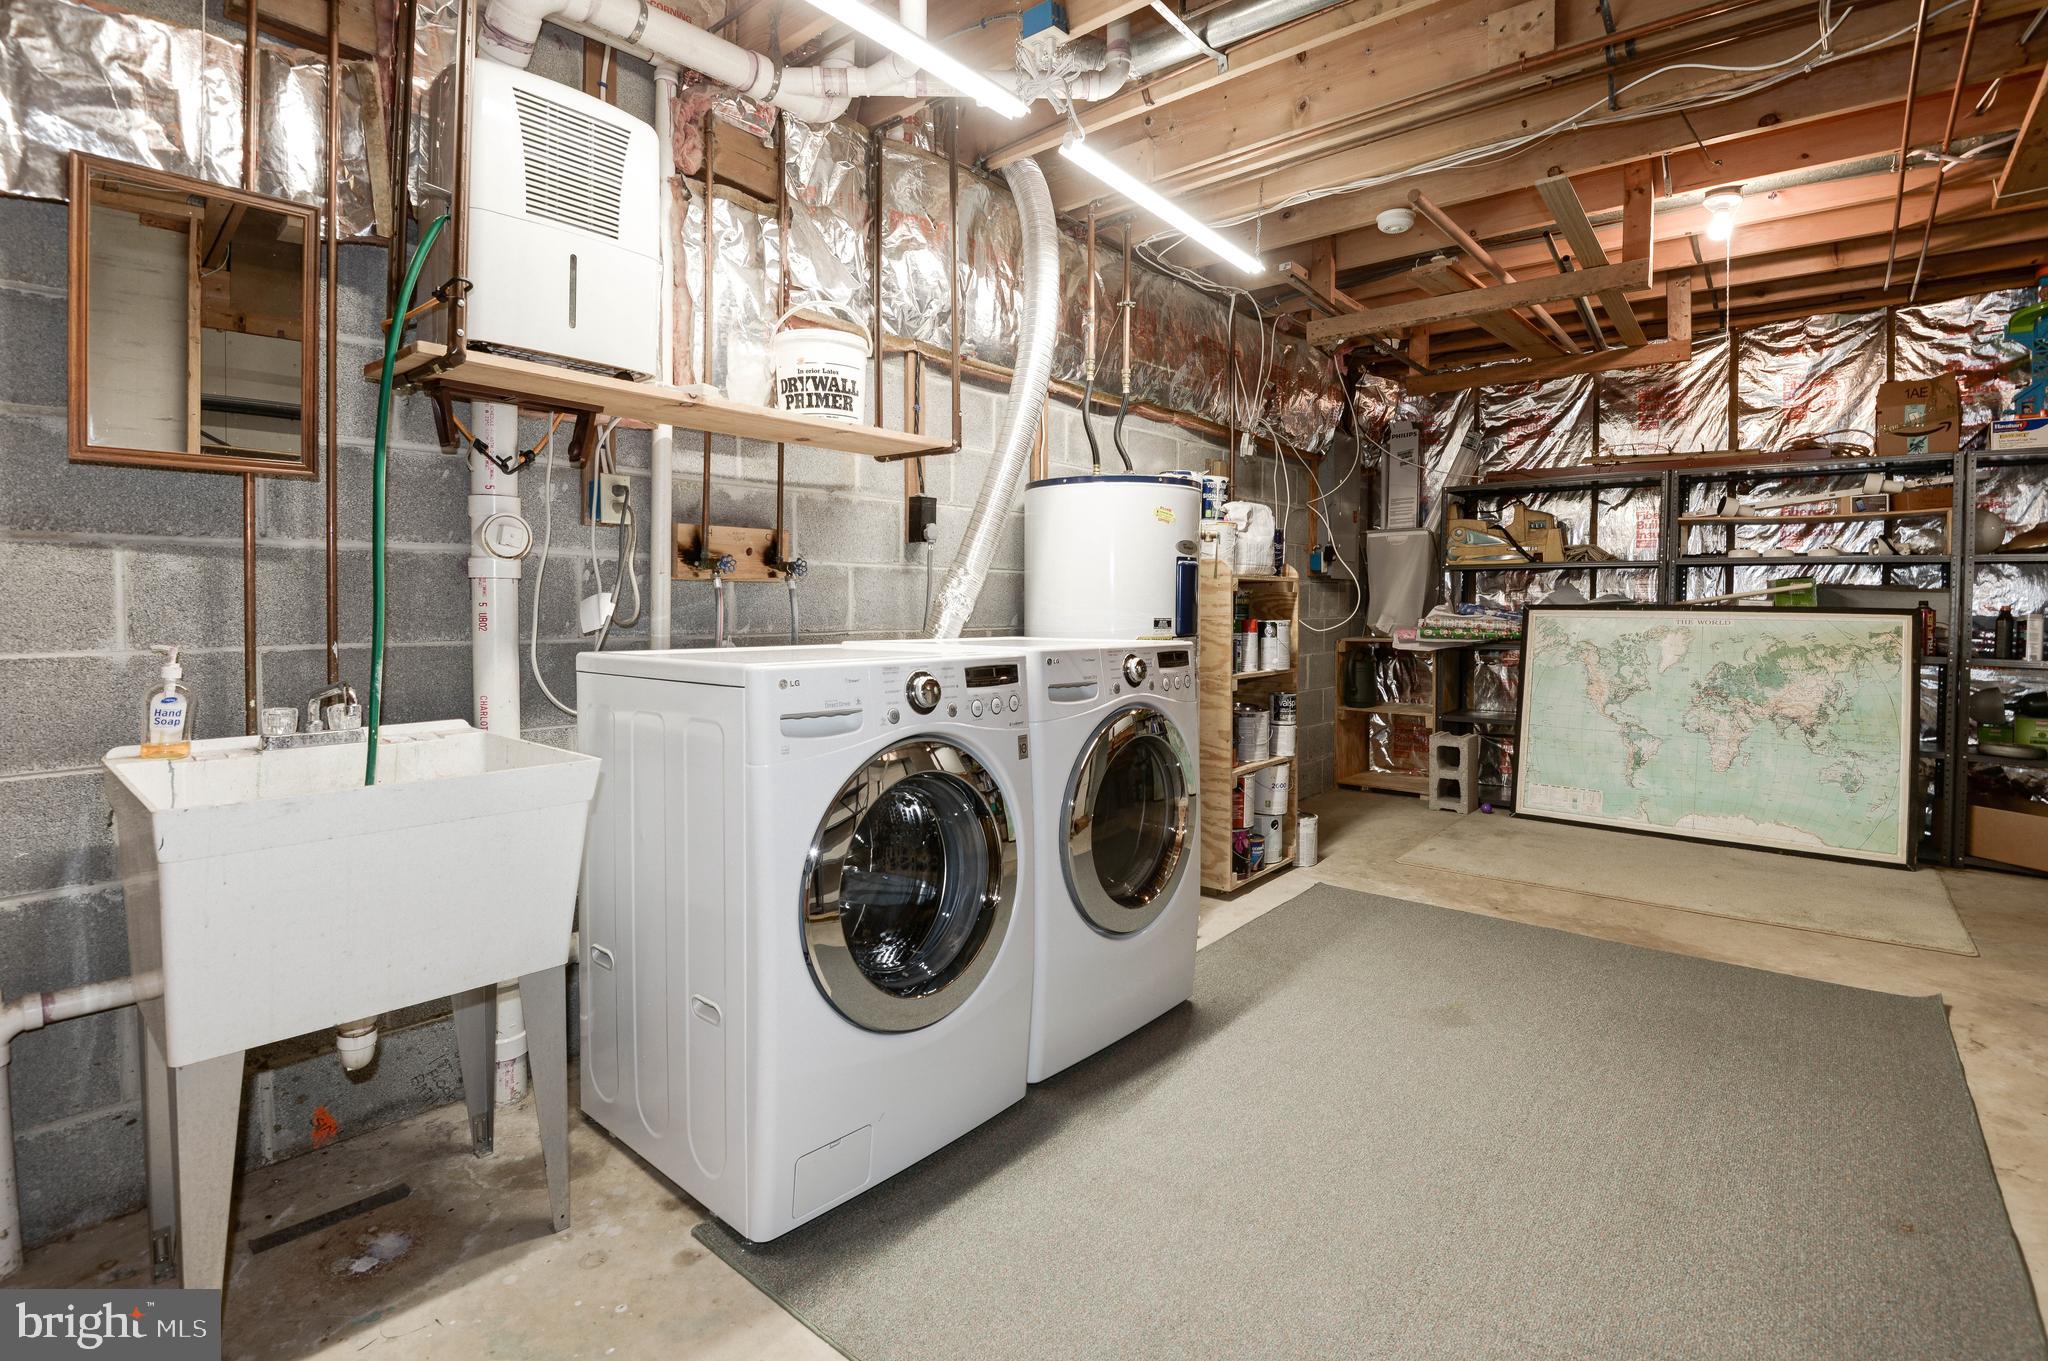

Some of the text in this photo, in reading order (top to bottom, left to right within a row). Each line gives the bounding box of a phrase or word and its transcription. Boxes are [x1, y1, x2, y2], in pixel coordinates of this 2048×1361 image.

[780, 376, 859, 397] DRYWALL
[1904, 387, 1929, 399] 1AE
[785, 392, 854, 412] PRIMER
[1391, 431, 1418, 439] PHILIPS
[1927, 610, 1935, 655] TRUFUEL
[154, 709, 182, 717] Hand
[153, 717, 180, 727] Soap
